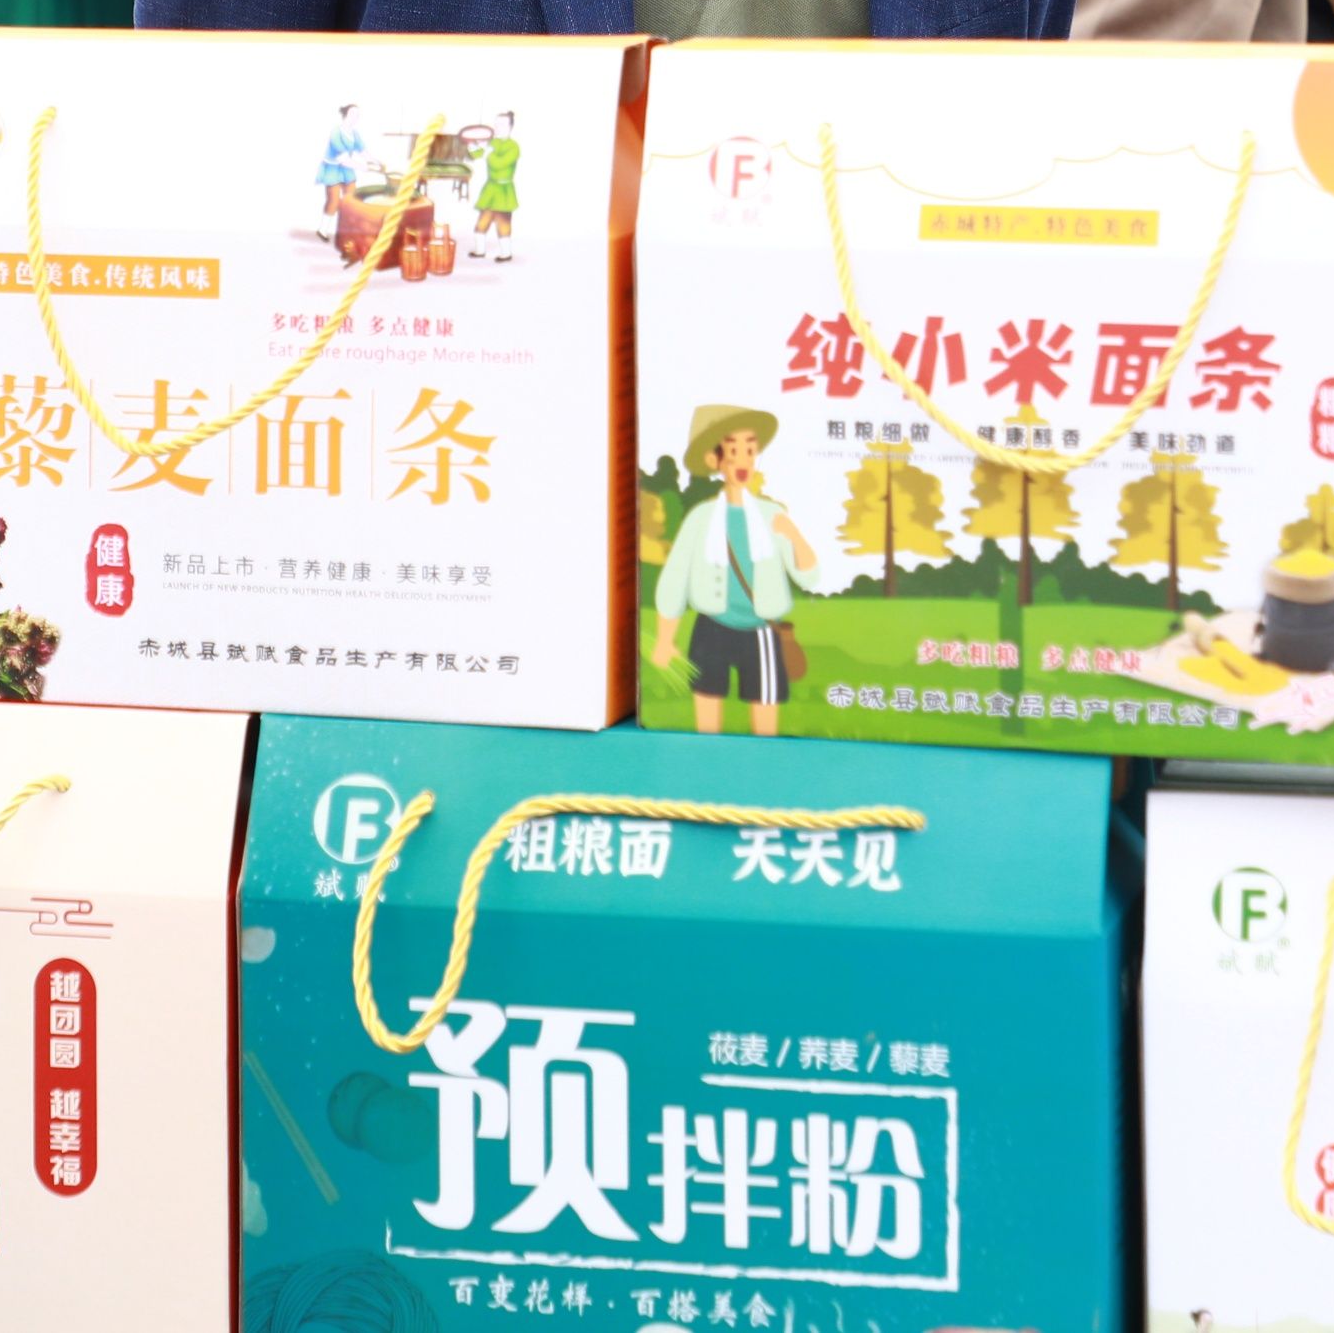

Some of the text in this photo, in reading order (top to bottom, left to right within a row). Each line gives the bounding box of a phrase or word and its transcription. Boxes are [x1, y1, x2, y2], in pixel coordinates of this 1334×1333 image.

[268, 342, 293, 357] Eat
[346, 345, 427, 364] roughage
[433, 348, 474, 363] More
[481, 349, 534, 365] health
[369, 315, 454, 337] 多点健康
[781, 312, 1281, 414] 纯小米面条
[827, 419, 931, 444] 粗粮细做
[1130, 431, 1236, 456] 美味劲道
[94, 534, 125, 607] 健康
[138, 637, 521, 675] 赤城县斌赋食品生产有限公司
[1042, 645, 1142, 673] 多点健康
[505, 815, 902, 892] 粗粮面 天天见
[49, 970, 82, 1187] 越团圆 越幸福
[408, 996, 926, 1260] 预拌粉
